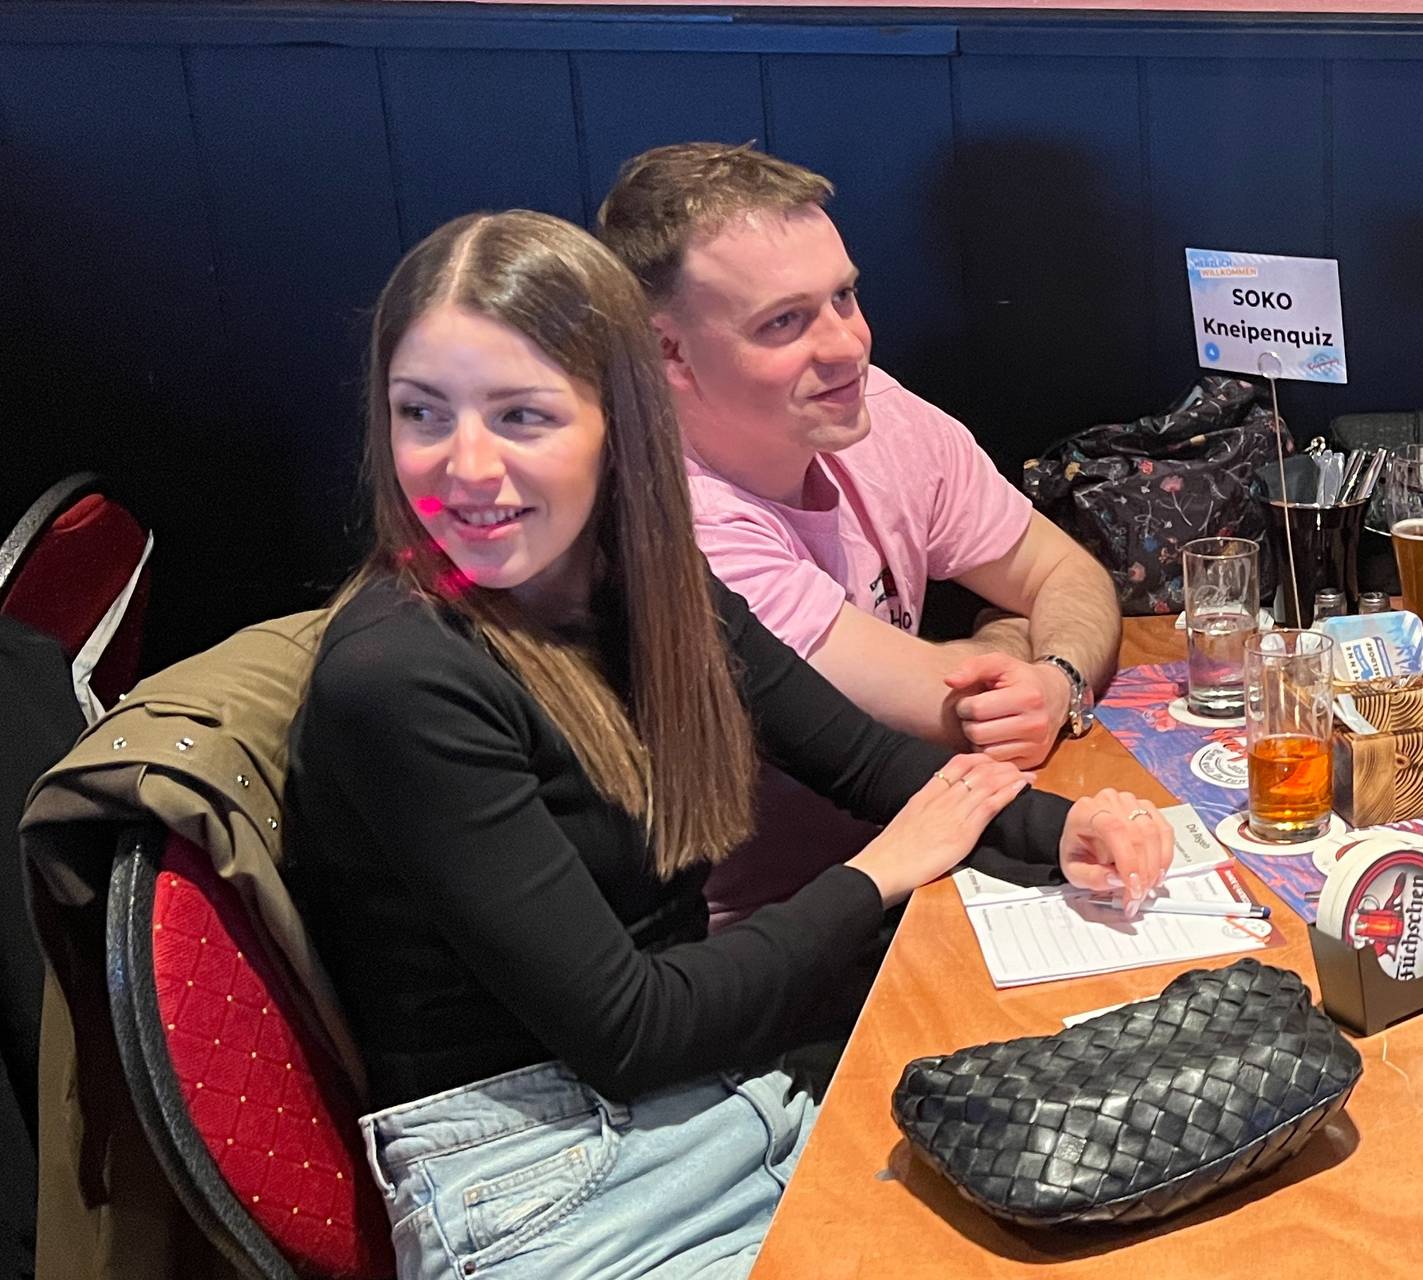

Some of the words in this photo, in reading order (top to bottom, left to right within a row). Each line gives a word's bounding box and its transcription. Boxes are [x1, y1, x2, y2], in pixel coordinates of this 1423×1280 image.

[1232, 288, 1292, 310] SOKO
[1203, 317, 1333, 348] Kneipenquiz
[1346, 645, 1360, 680] TENNE
[1366, 642, 1381, 676] SELDORF
